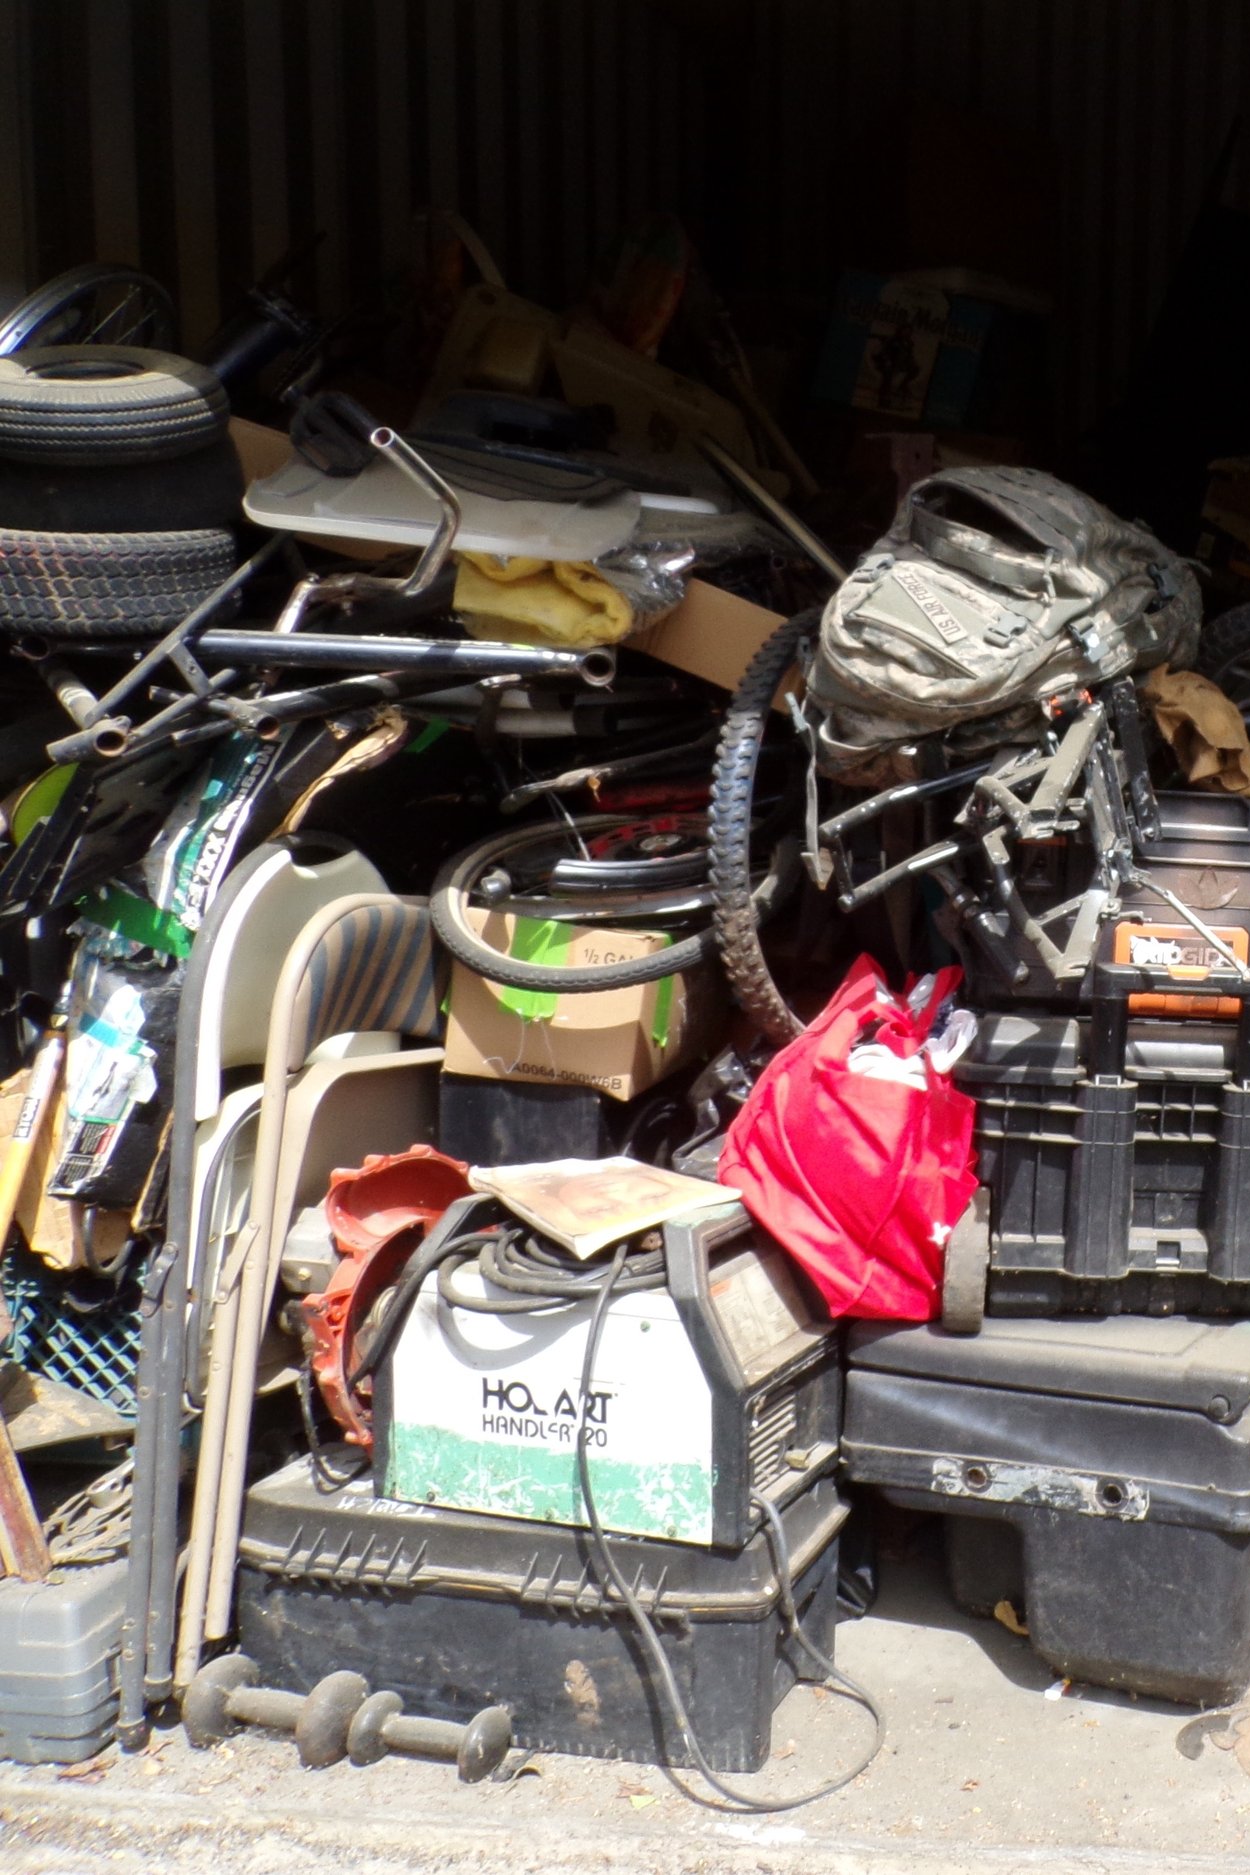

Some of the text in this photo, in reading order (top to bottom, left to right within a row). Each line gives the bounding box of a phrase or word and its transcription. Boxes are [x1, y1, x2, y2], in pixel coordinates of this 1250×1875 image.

[897, 572, 935, 601] FORCE
[923, 598, 950, 617] AIR
[482, 1377, 613, 1424] HOART
[579, 1426, 608, 1448] 20
